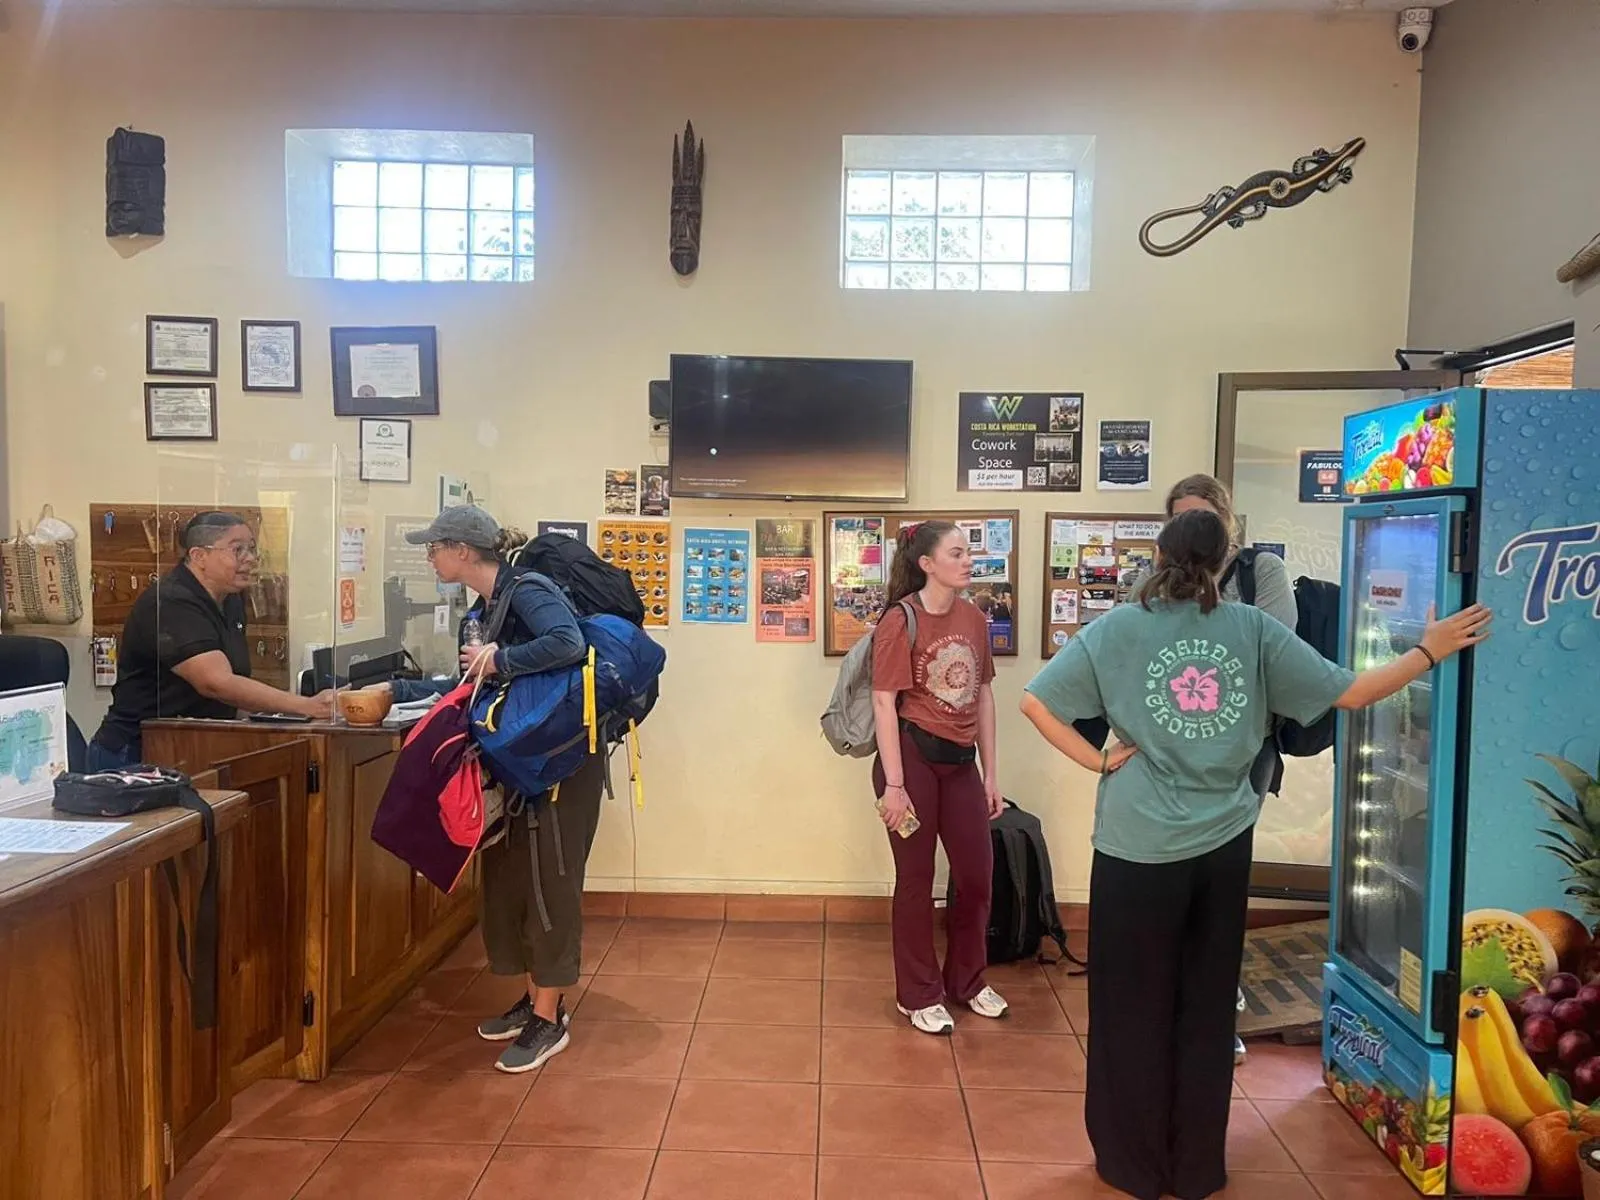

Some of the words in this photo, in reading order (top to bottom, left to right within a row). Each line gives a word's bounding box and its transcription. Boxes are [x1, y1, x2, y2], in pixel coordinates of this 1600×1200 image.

[970, 423, 987, 431] COSTA
[988, 423, 1001, 431] RICA
[1002, 423, 1037, 431] WORKSTATION
[971, 438, 1017, 451] Cowork
[978, 456, 1013, 470] Space
[776, 524, 793, 534] BAR
[44, 556, 60, 604] RICA
[1496, 521, 1600, 625] Tro
[2, 556, 16, 613] COSTA
